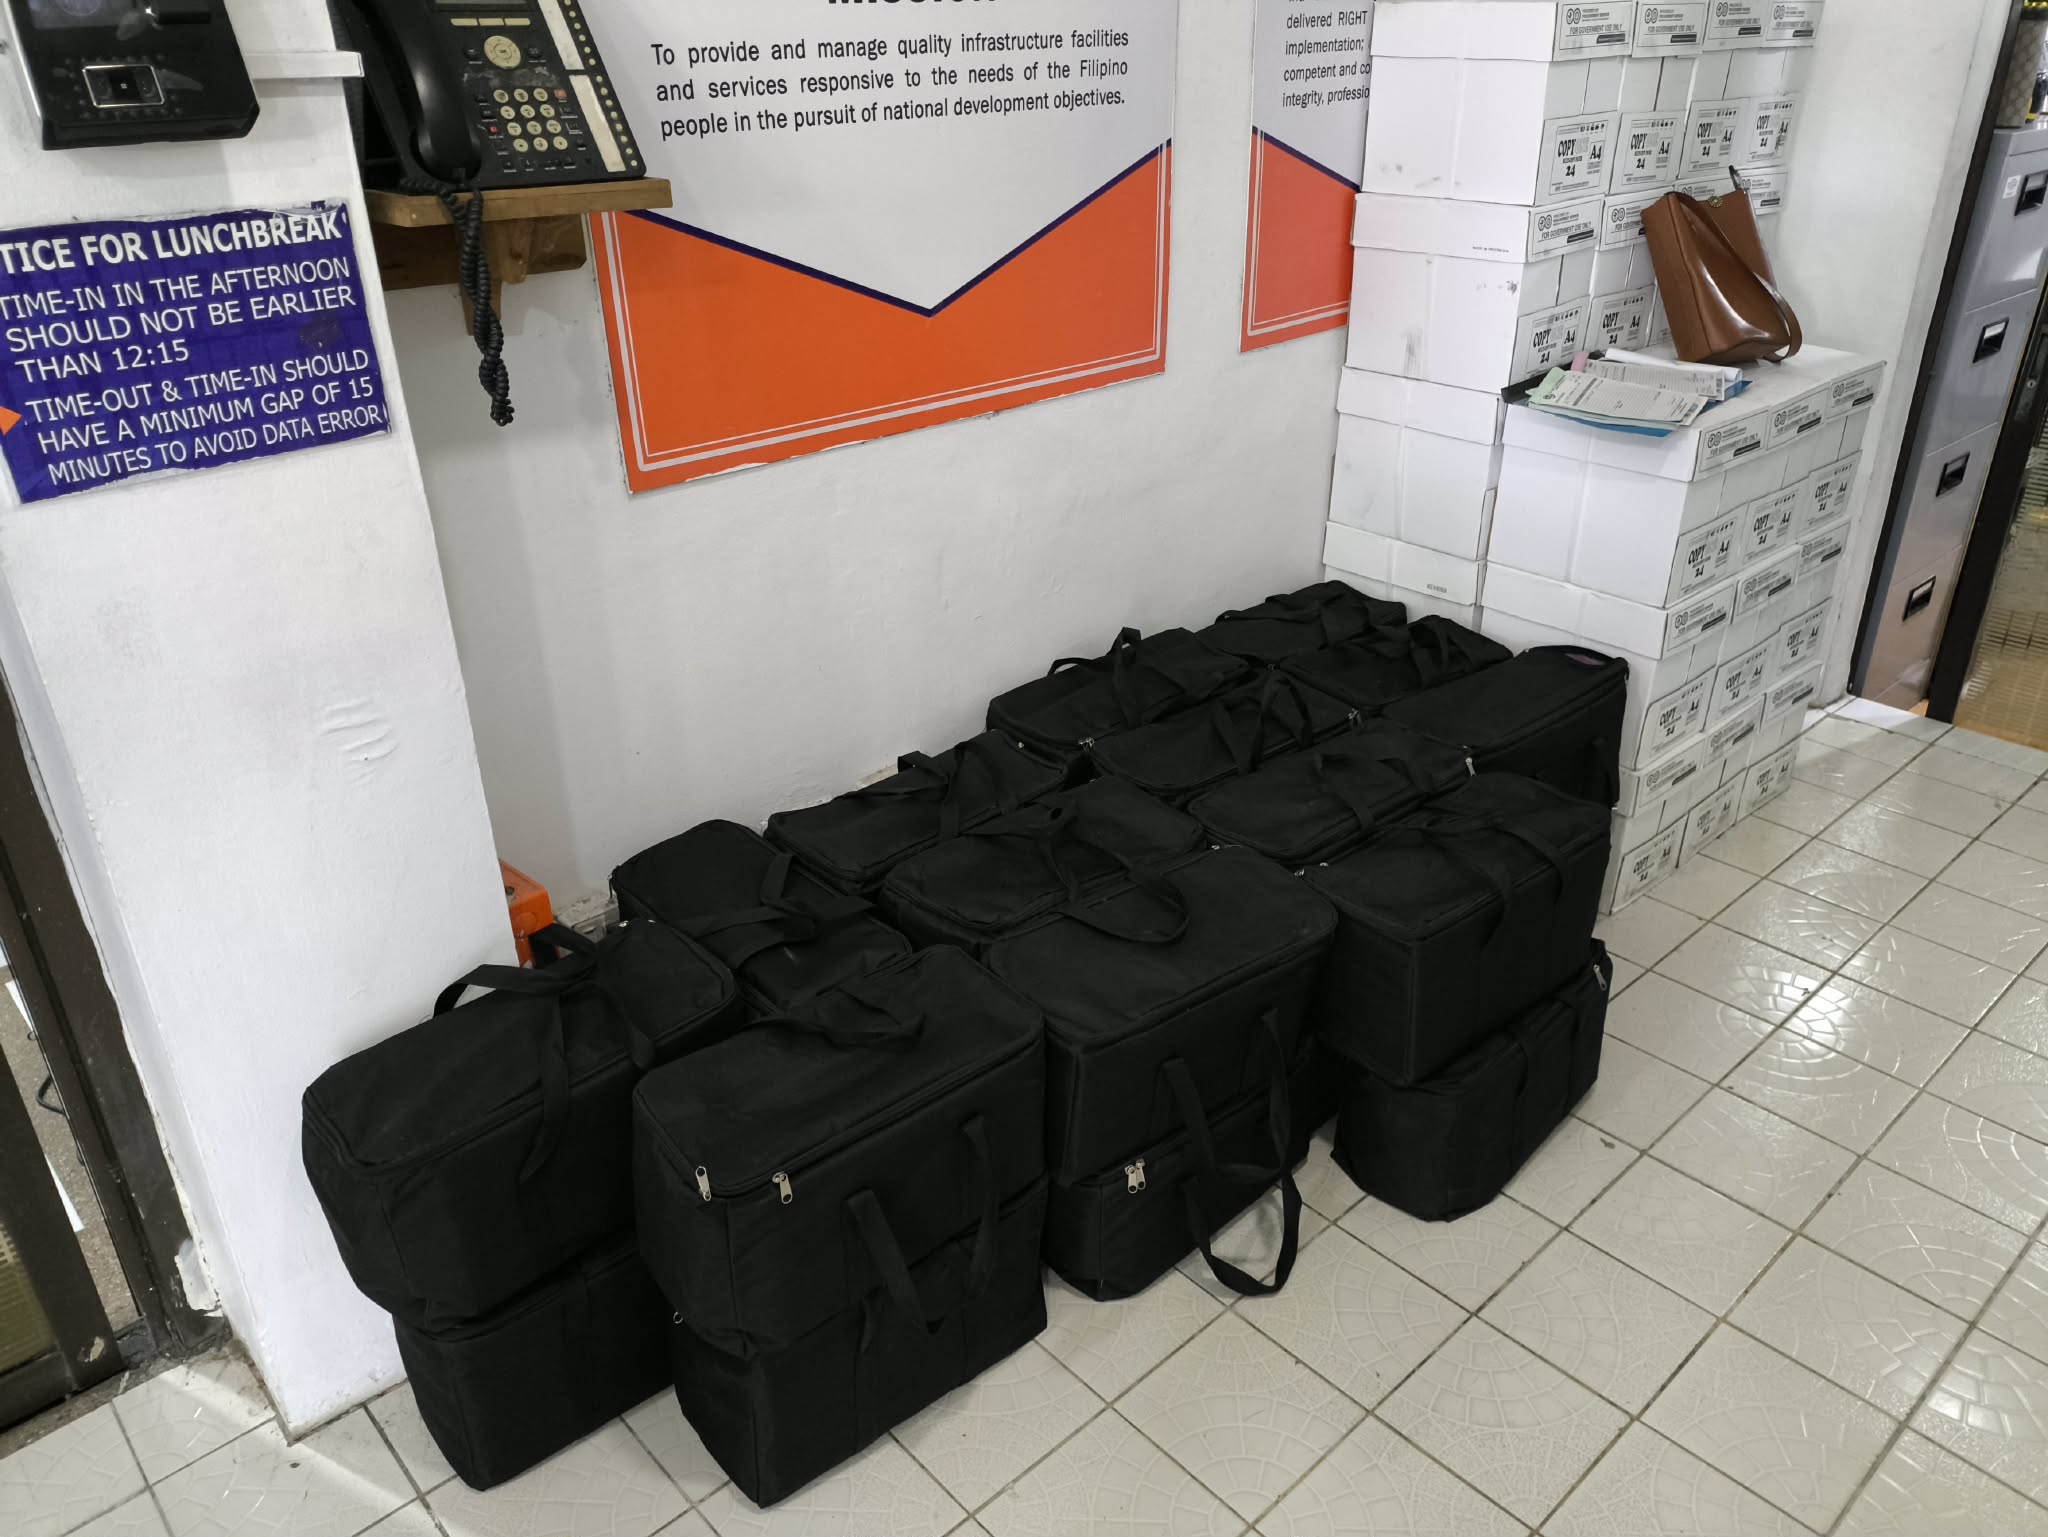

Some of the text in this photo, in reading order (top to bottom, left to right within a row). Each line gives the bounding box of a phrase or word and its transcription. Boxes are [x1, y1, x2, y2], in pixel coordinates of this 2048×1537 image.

[1286, 10, 1368, 29] delivered RIGHT
[650, 29, 1130, 68] To provide and manage quality infrastructure facilities
[1285, 37, 1364, 56] implementation;
[655, 58, 1128, 103] and services responsive to the needs of the Filipino
[1284, 64, 1336, 82] competent
[1339, 61, 1357, 77] and
[1282, 86, 1370, 109] integrity, professio
[661, 87, 1125, 142] people in the pursuit of national development objectives.
[1757, 116, 1770, 130] COPY
[1631, 133, 1648, 149] COPY
[1697, 124, 1712, 139] COPY
[1557, 139, 1576, 157] COPY
[1590, 144, 1602, 160] A4
[1659, 140, 1670, 155] A4
[80, 232, 148, 266] FOR
[151, 212, 342, 259] LUNCHBREAK
[0, 256, 351, 321] TIME-IN IN THE AFTERNOON
[5, 284, 356, 353] SHOULD NOT BE EARLIER
[1602, 312, 1618, 328] COPY
[1533, 329, 1552, 348] COPY
[1564, 329, 1576, 345] A4
[14, 338, 190, 384] THAN 12:15
[25, 348, 370, 425] TIME-OUT & TIME-IN SHOULD
[37, 375, 374, 455] HAVE A MINIMUM GAP OF 15
[47, 403, 384, 486] MINUTES TO AVOID DATA ERROR
[1815, 482, 1830, 499] COPY
[1753, 514, 1770, 532] COPY
[1688, 544, 1707, 565] COPY
[1726, 672, 1742, 690] COPY
[1660, 706, 1677, 726] COPY
